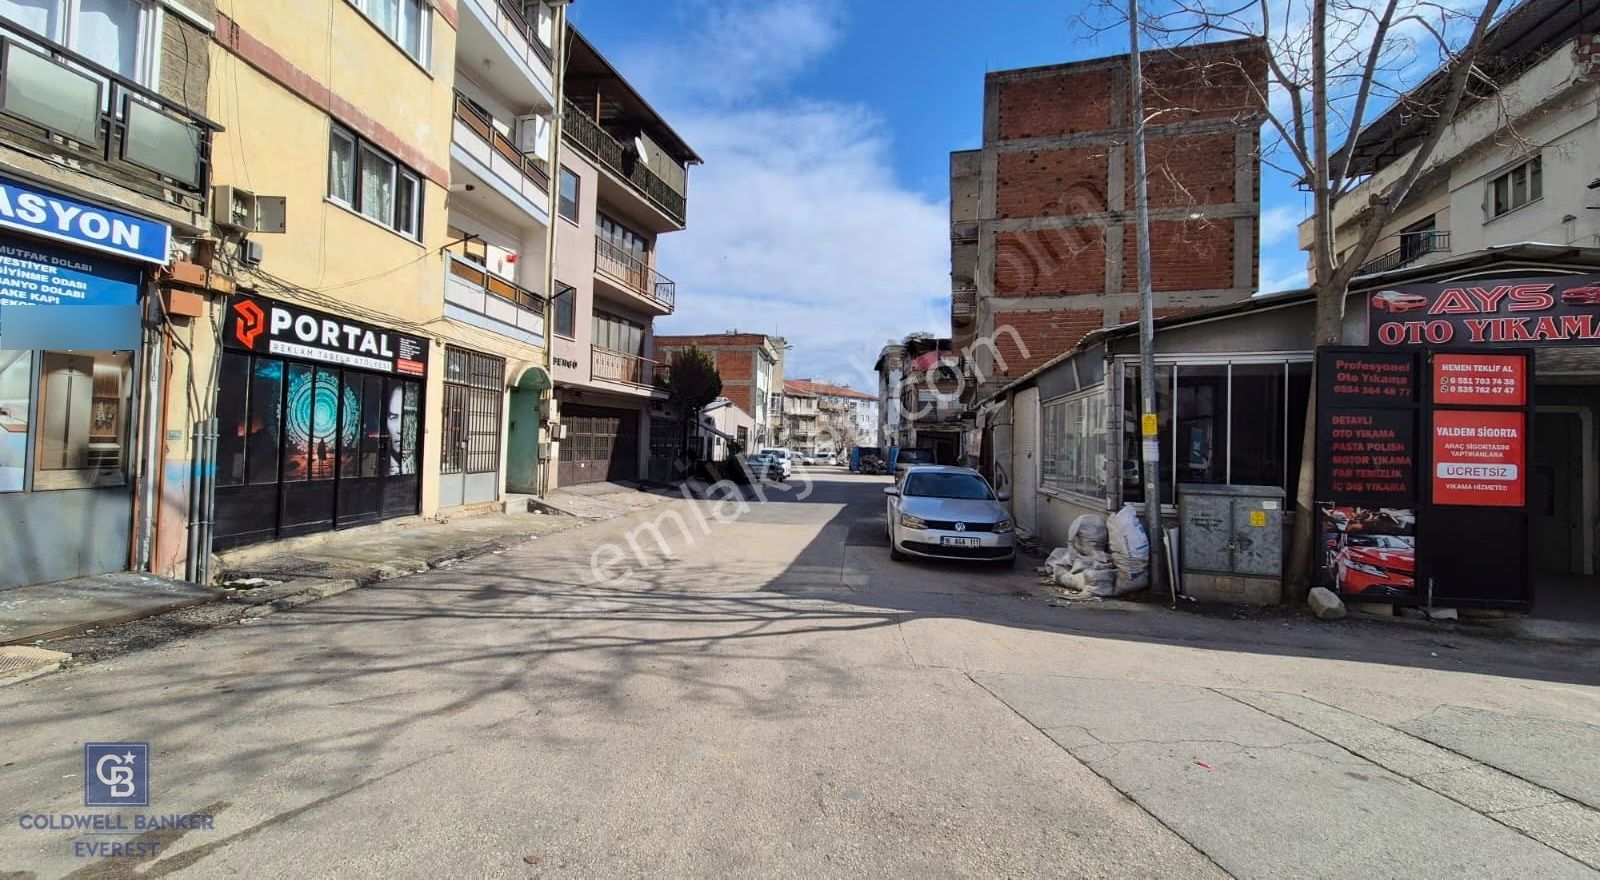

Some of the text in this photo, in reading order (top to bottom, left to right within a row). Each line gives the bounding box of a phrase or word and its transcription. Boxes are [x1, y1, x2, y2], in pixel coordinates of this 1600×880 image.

[51, 256, 93, 272] DOLABI
[52, 277, 87, 290] ODASI
[0, 287, 27, 299] AKE
[30, 292, 60, 305] KAPI
[41, 285, 85, 299] DOLABI
[1428, 284, 1554, 314] AYS
[270, 307, 393, 357] PORTAL
[1378, 320, 1453, 345] OTO
[273, 343, 313, 357] REKLAM
[319, 351, 350, 364] TABELA
[1336, 360, 1410, 372] Profesyonel
[1473, 364, 1501, 372] TEKLİF
[1503, 365, 1513, 373] AL
[1337, 372, 1408, 384] Oto Yıkama
[1332, 416, 1373, 425] DETAYLI
[1332, 429, 1395, 438] OTO YIKAMA
[1477, 426, 1518, 438] SİGORTA
[1333, 442, 1364, 451] PASTA
[1445, 443, 1464, 451] ARAÇ
[1333, 455, 1412, 465] MOTOR YIKAMA
[1333, 469, 1352, 477] FAR
[1366, 482, 1406, 491] YIKAMA
